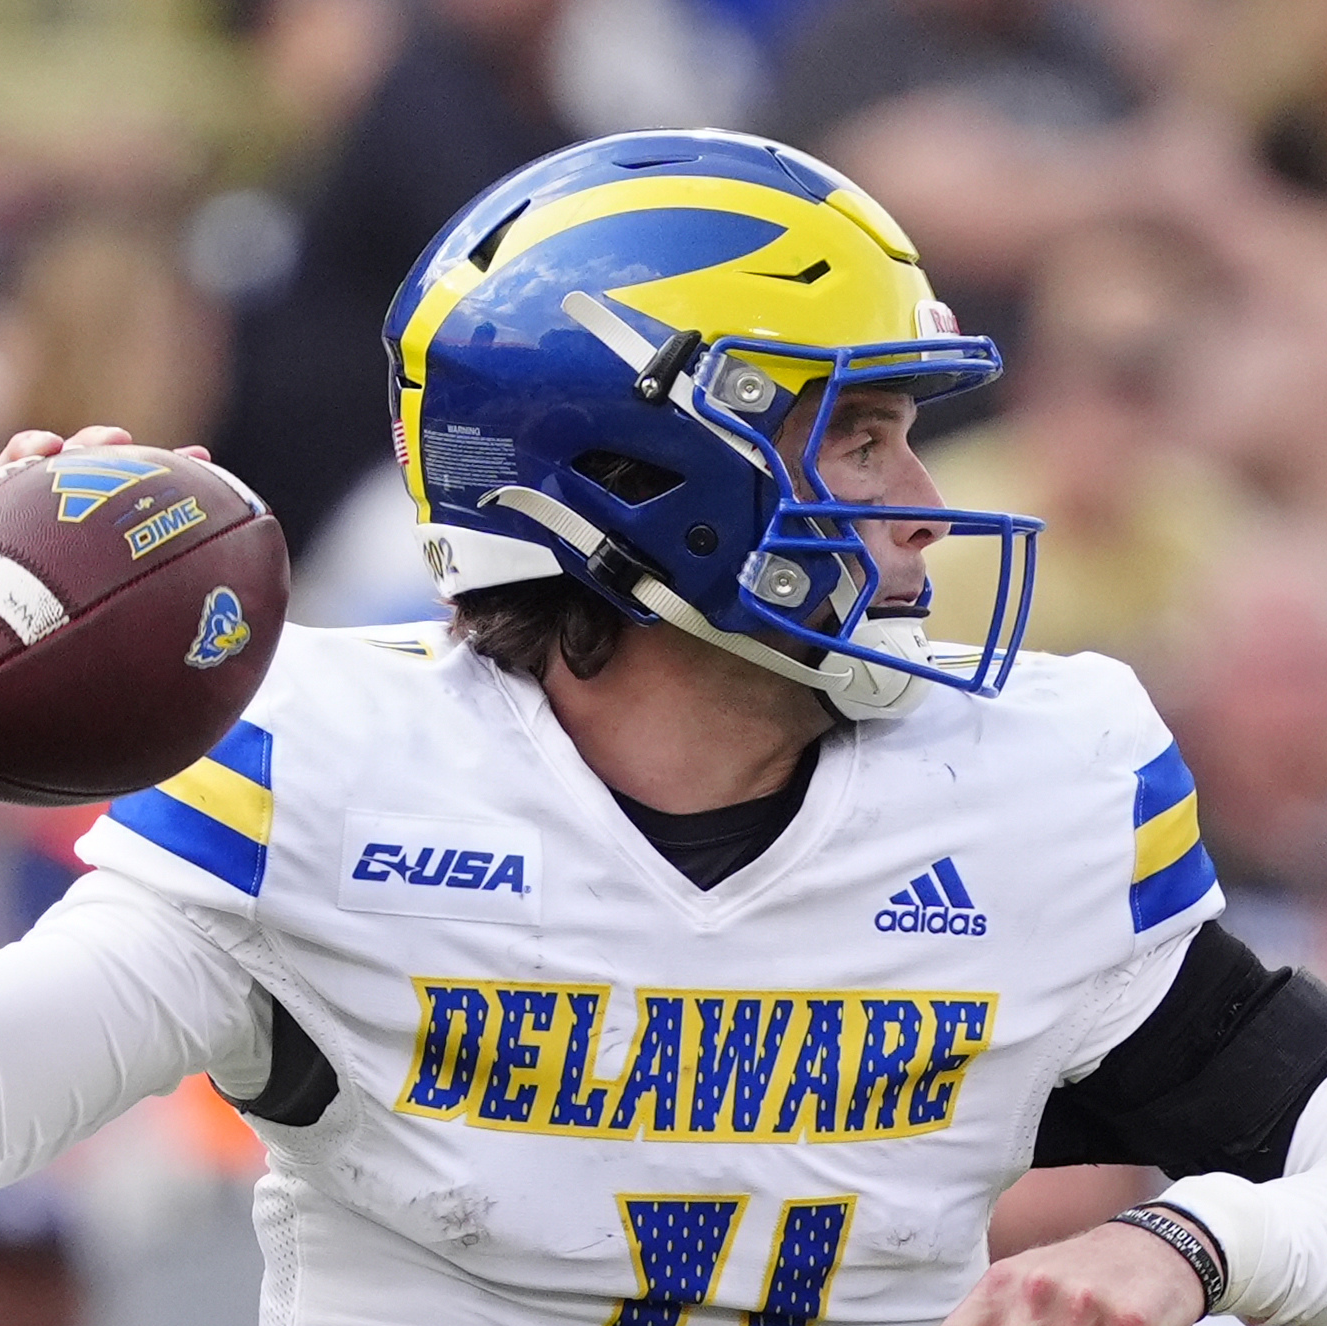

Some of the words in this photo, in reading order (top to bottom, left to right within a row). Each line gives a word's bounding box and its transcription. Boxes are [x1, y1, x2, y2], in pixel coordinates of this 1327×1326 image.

[126, 498, 205, 557] DIME
[874, 904, 987, 937] adidas
[396, 977, 998, 1142] DELAWARE
[1150, 1216, 1202, 1254] MIGHTY
